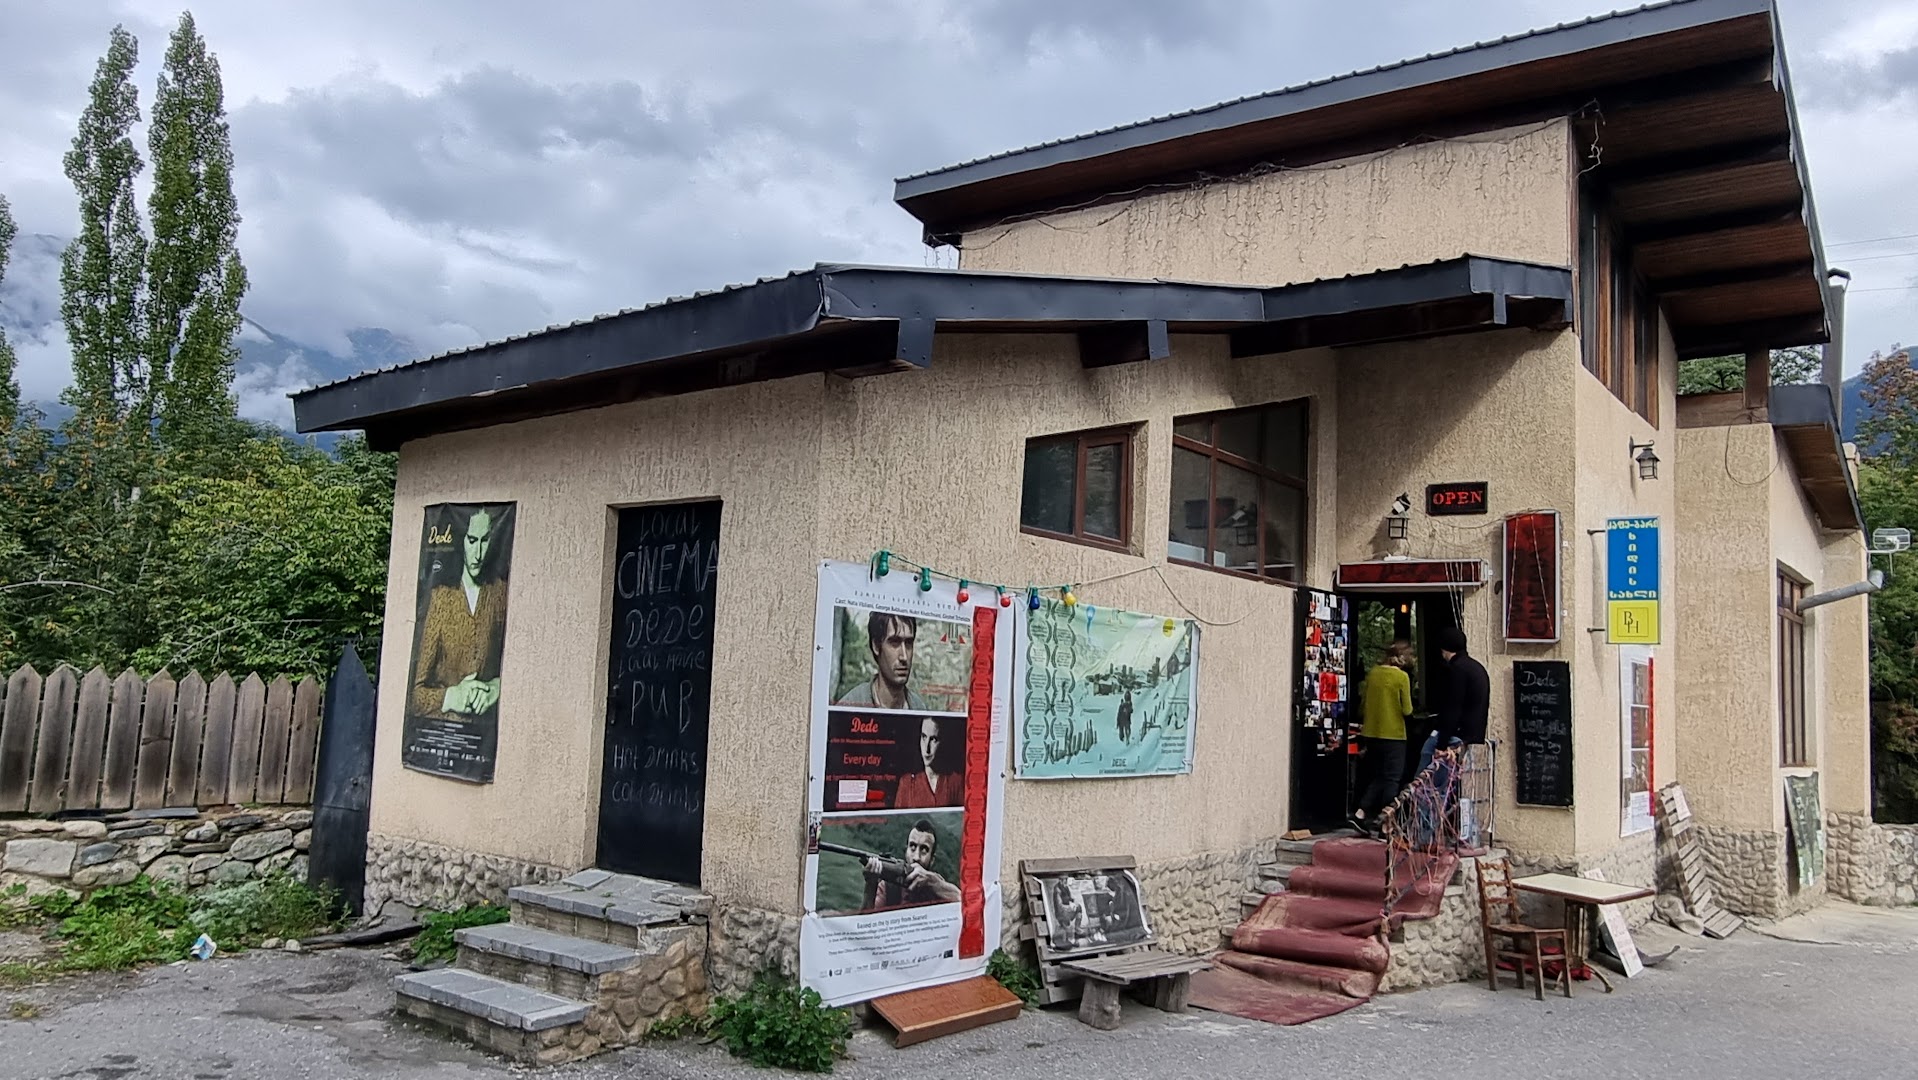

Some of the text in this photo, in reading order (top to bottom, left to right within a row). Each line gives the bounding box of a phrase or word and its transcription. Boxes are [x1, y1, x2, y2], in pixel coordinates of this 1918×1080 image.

[1433, 491, 1483, 505] OPEN
[428, 523, 453, 544] Dede
[1520, 670, 1559, 687] Dede
[851, 717, 878, 732] Dede
[843, 753, 881, 766] Every day
